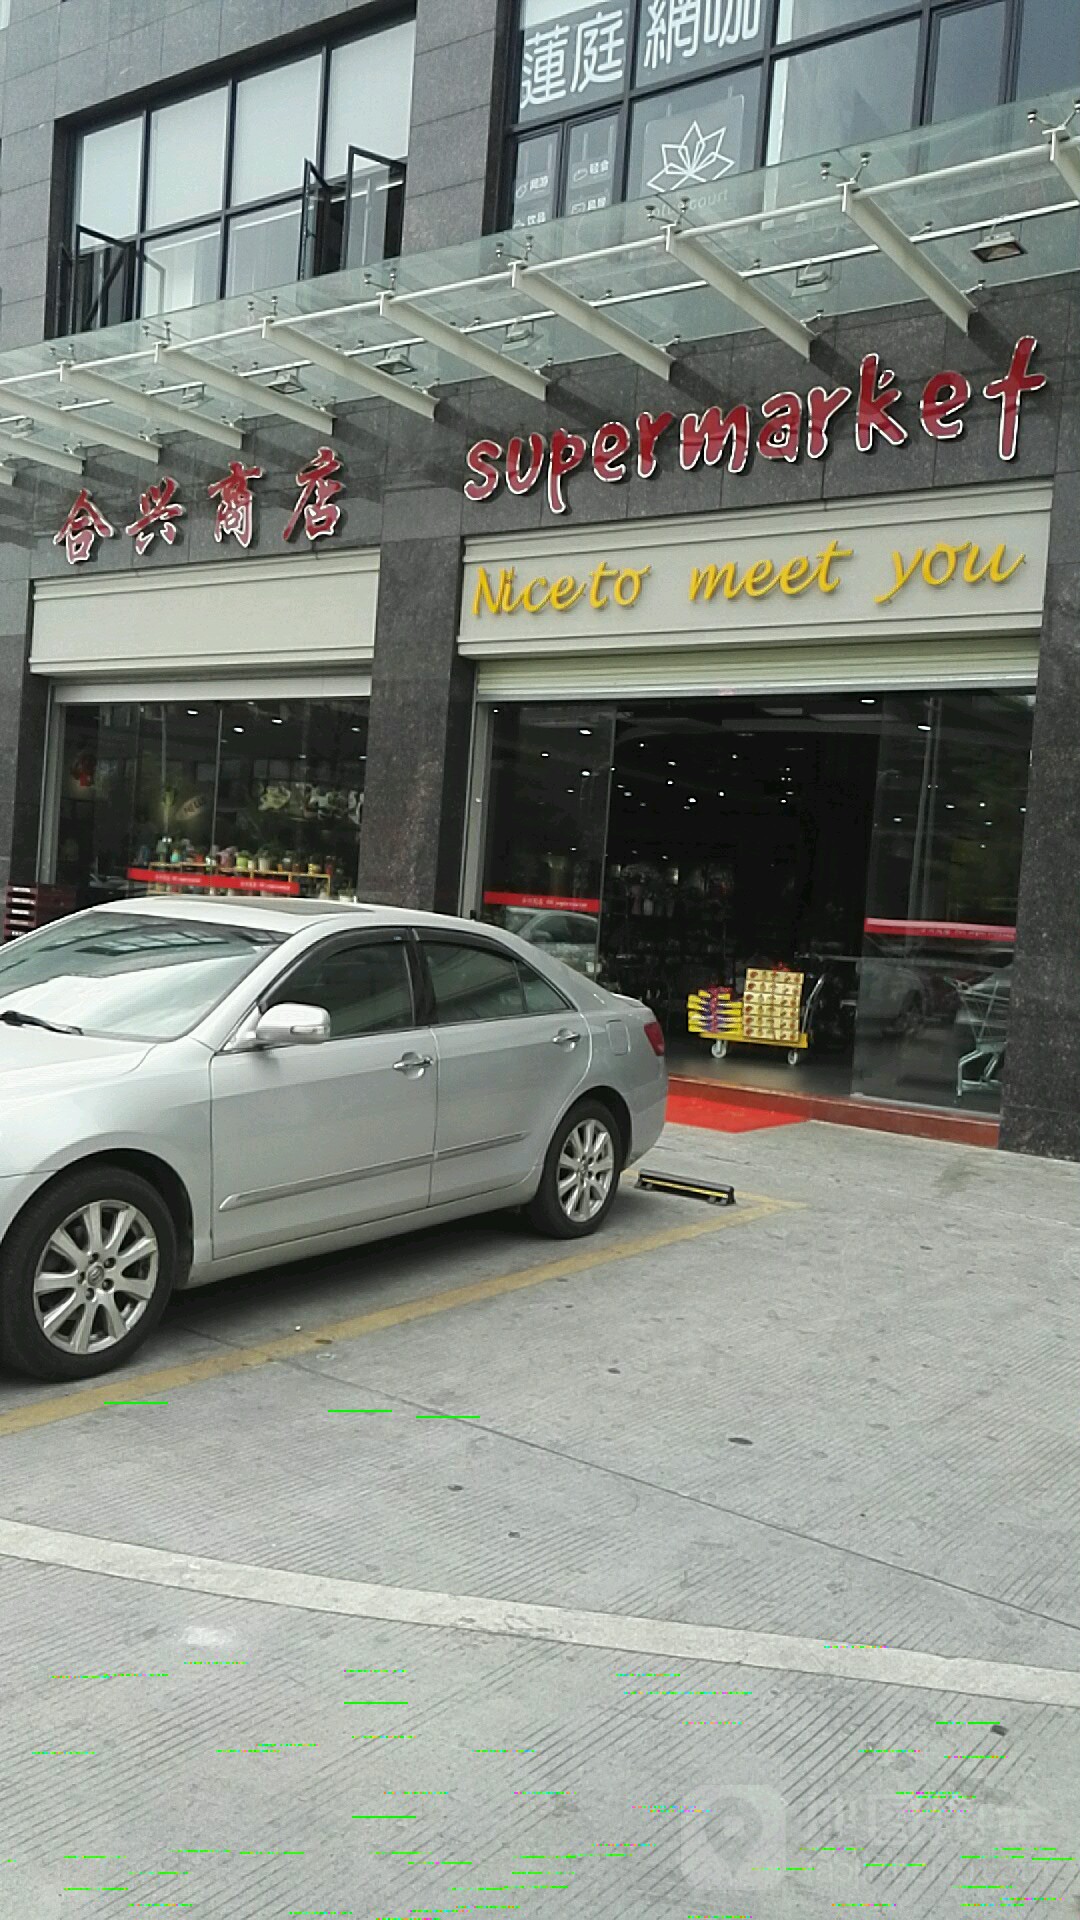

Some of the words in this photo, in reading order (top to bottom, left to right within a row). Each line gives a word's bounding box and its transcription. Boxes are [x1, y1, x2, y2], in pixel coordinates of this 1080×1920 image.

[463, 335, 1047, 513] supermarket
[53, 446, 343, 564] 合兴商店
[688, 540, 854, 602] meet
[874, 540, 1026, 605] you
